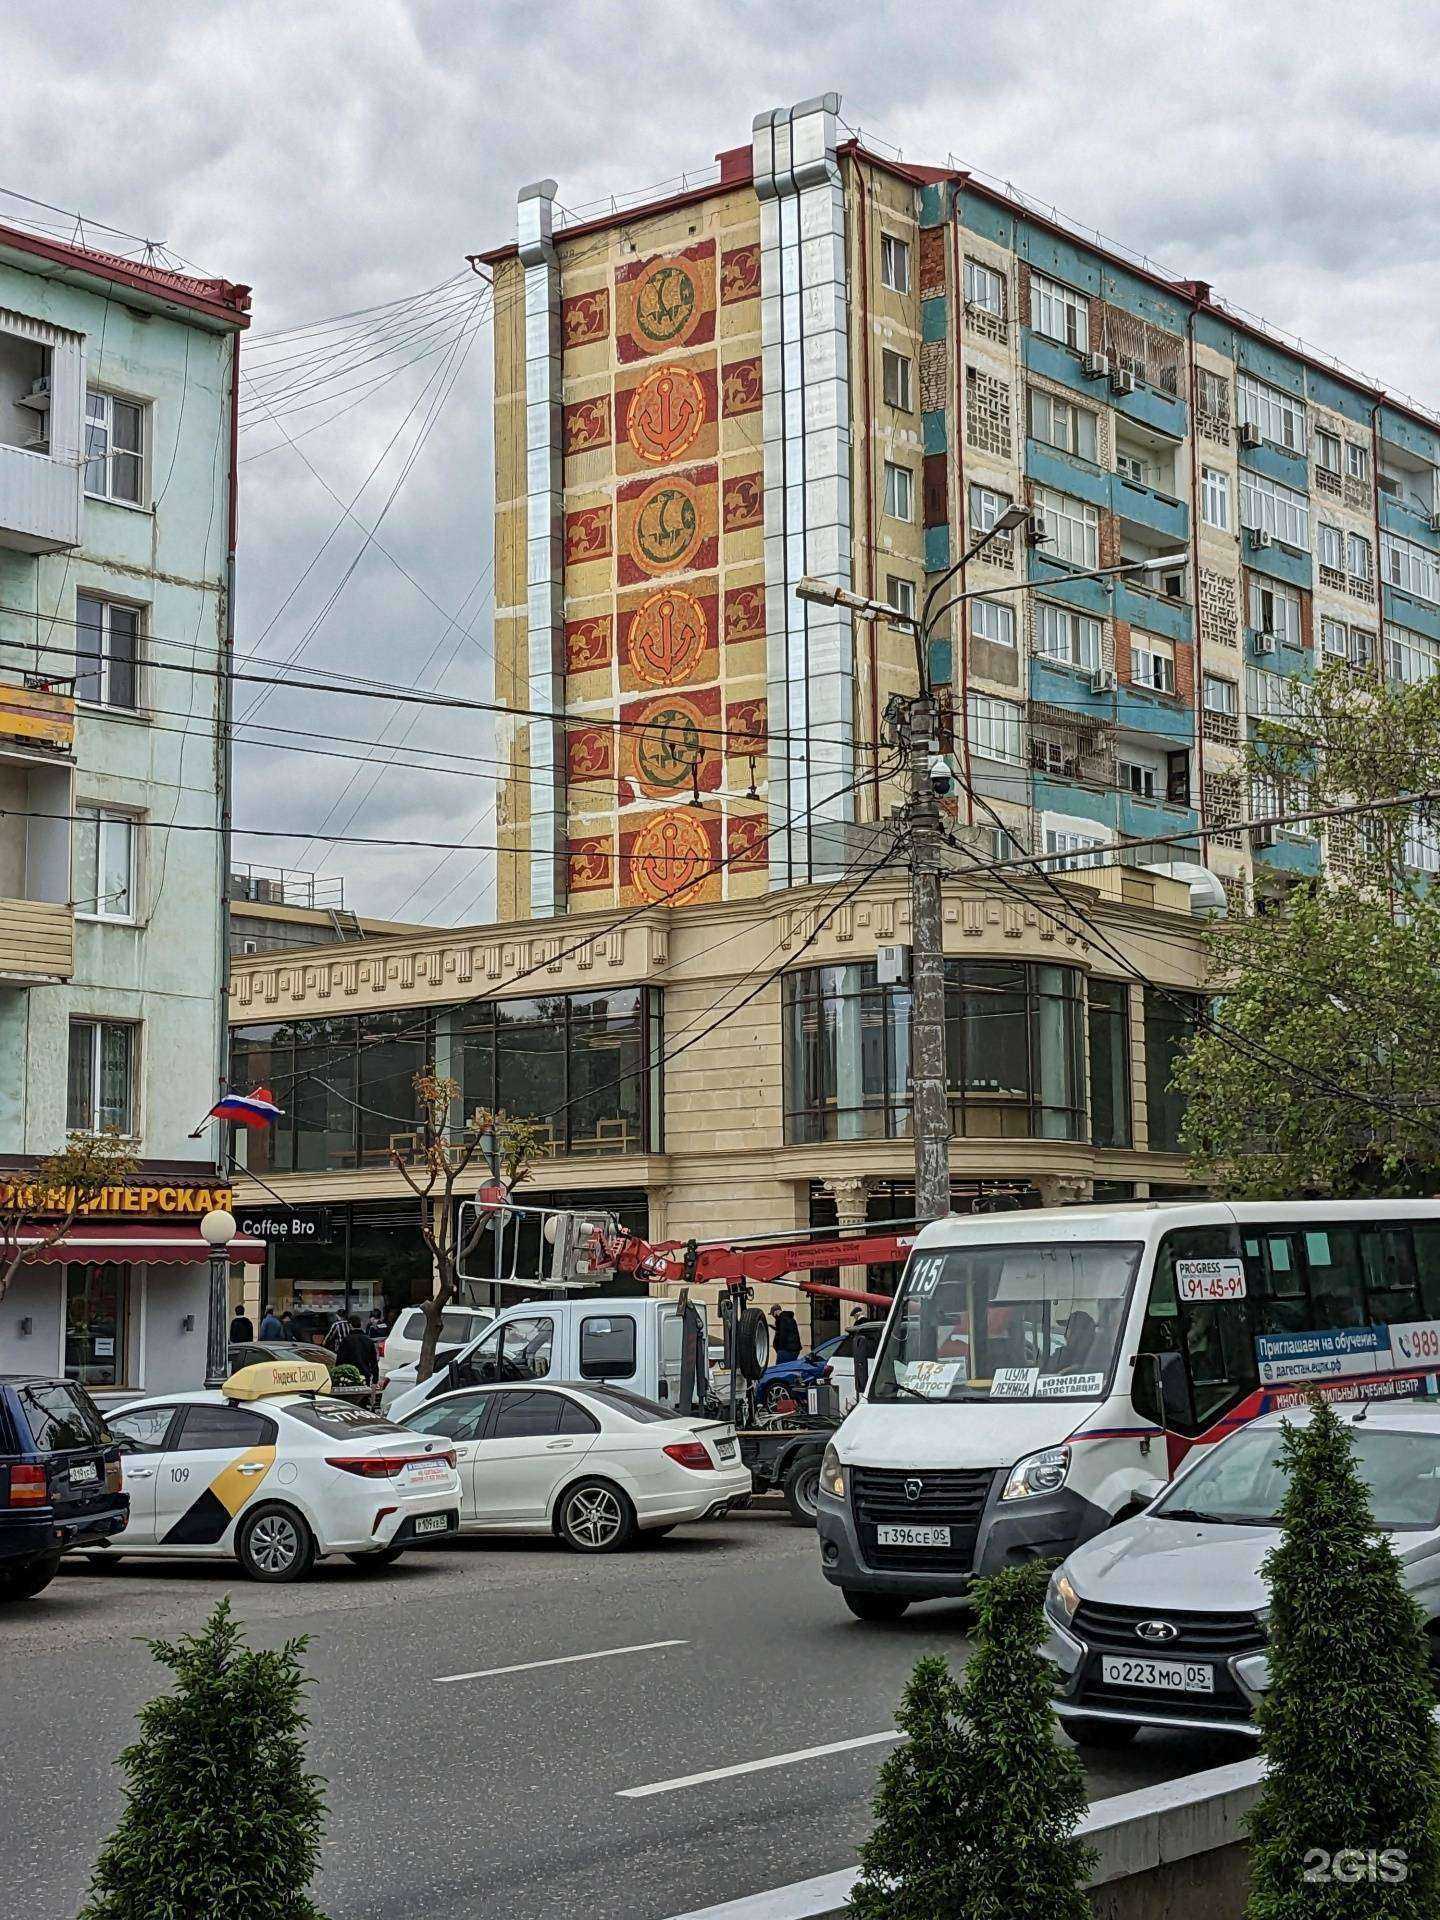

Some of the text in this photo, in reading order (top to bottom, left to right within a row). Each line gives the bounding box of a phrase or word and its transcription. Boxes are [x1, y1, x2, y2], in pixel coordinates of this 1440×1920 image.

[243, 1220, 315, 1235] Coffee Bro
[908, 1258, 942, 1292] 115
[1180, 1262, 1220, 1275] PROGRESS
[1188, 1277, 1243, 1298] 91-45-91
[1259, 1332, 1377, 1359] Приглашаем на обучение
[1412, 1330, 1439, 1358] 989
[272, 1367, 317, 1386] Яндекс Такси
[1005, 1368, 1029, 1381] ЦУМ
[1042, 1376, 1096, 1388] ЮЖНАЯ
[1276, 1383, 1361, 1408] МНОГОПФИЛЬНЫЙ
[1396, 1378, 1419, 1393] ЦЕНТР
[171, 1468, 190, 1482] 109
[933, 1529, 946, 1540] 05
[1187, 1667, 1206, 1683] 05
